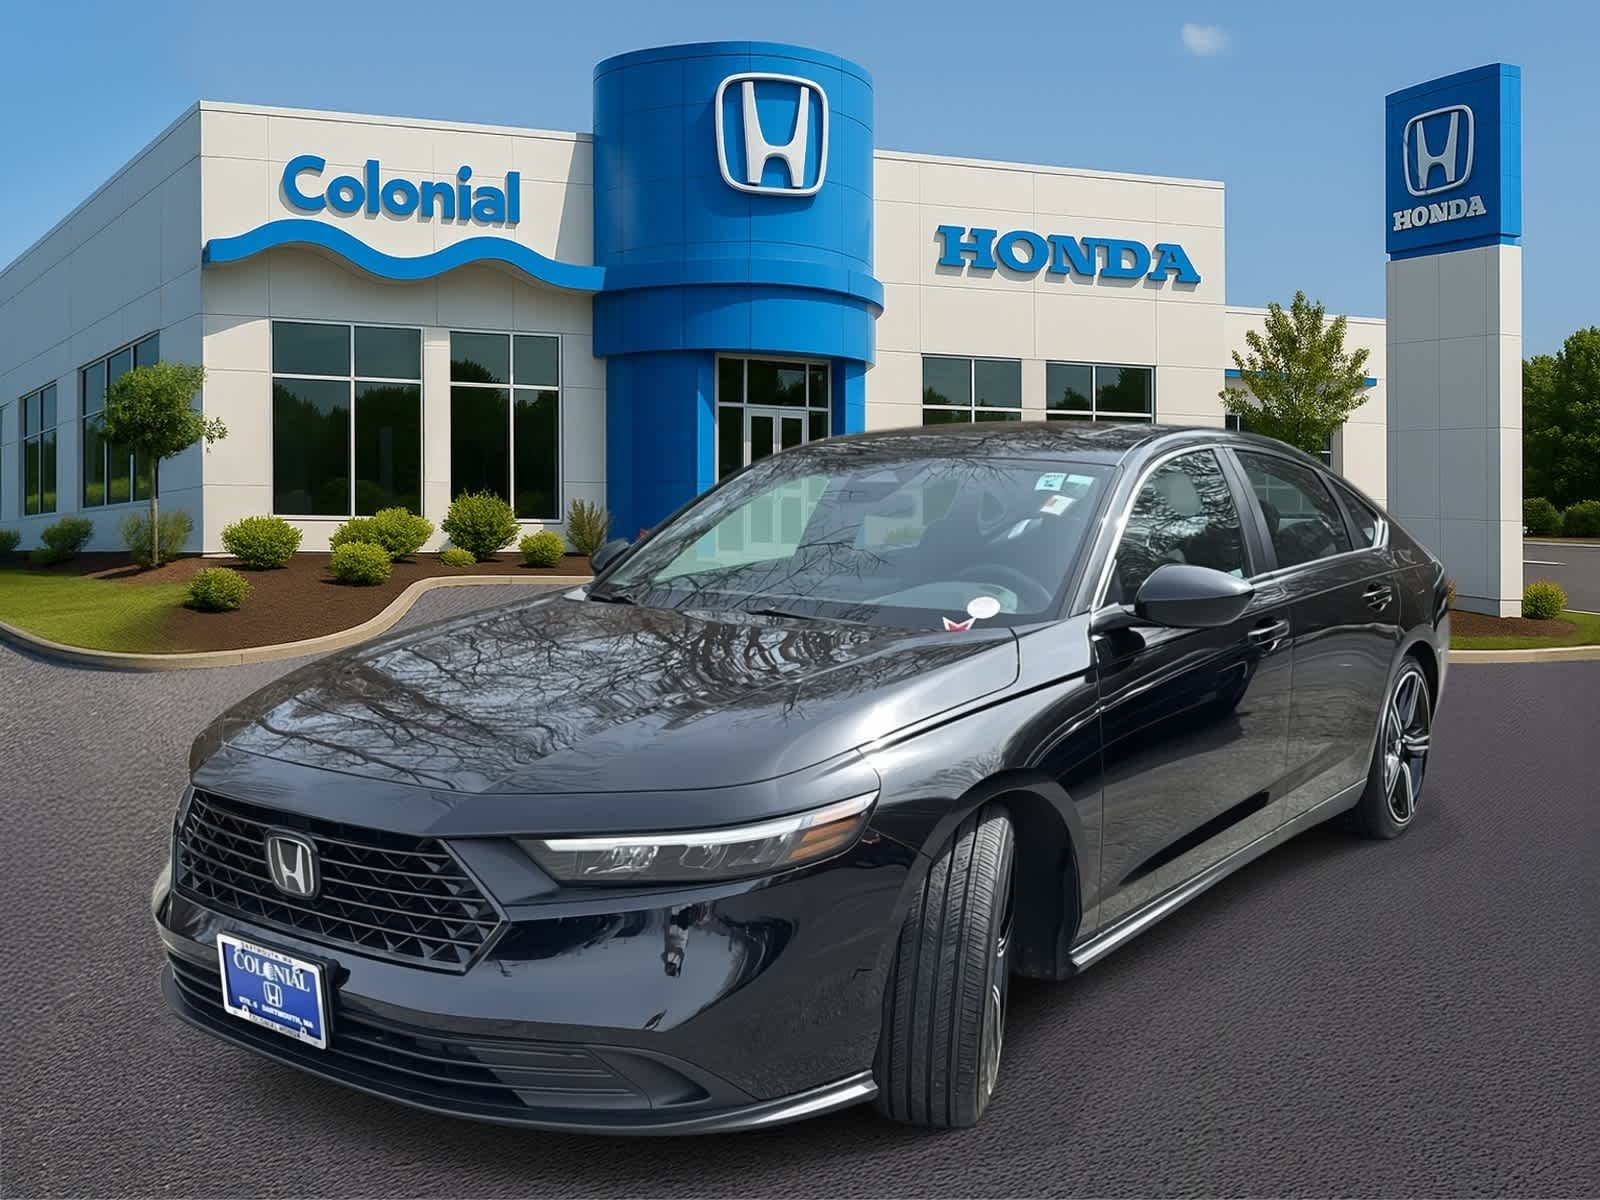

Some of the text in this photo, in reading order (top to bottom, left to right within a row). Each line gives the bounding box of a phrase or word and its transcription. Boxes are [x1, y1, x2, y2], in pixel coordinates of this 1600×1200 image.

[281, 154, 521, 227] Colonial
[1393, 195, 1487, 232] HONDA
[936, 224, 1201, 286] HONDA
